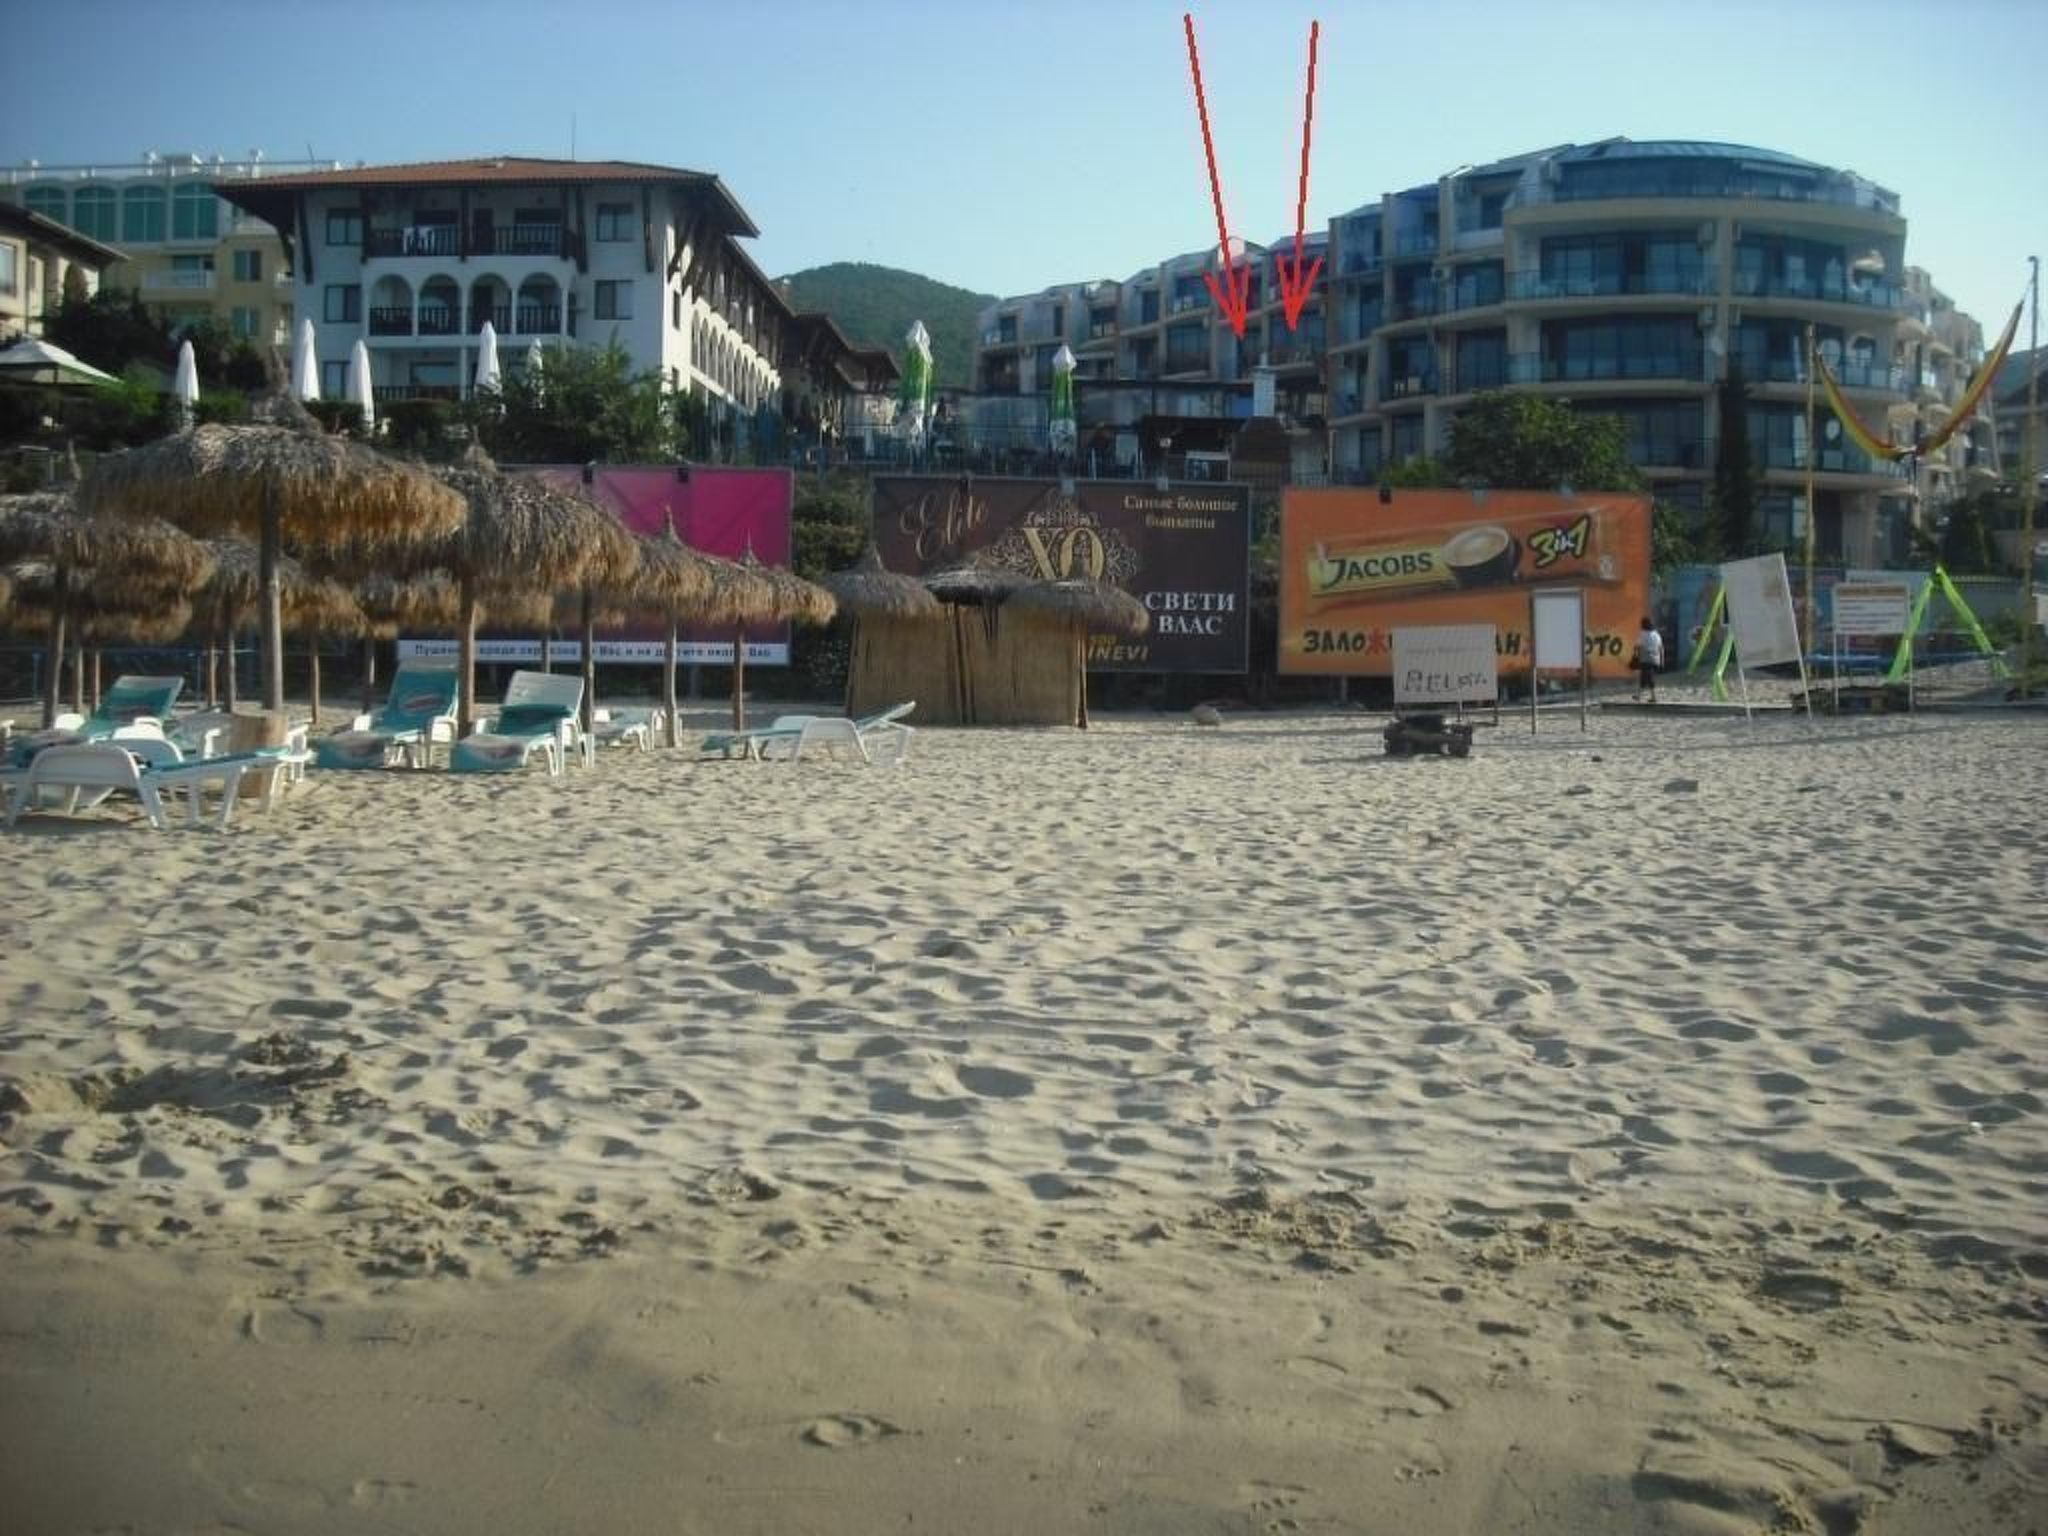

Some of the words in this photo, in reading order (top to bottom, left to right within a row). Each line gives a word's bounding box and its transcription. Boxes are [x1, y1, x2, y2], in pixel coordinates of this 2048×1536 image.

[1320, 552, 1434, 589] JACOBS
[1145, 591, 1236, 612] СВЕТИ
[1158, 615, 1224, 636] ВЛАС
